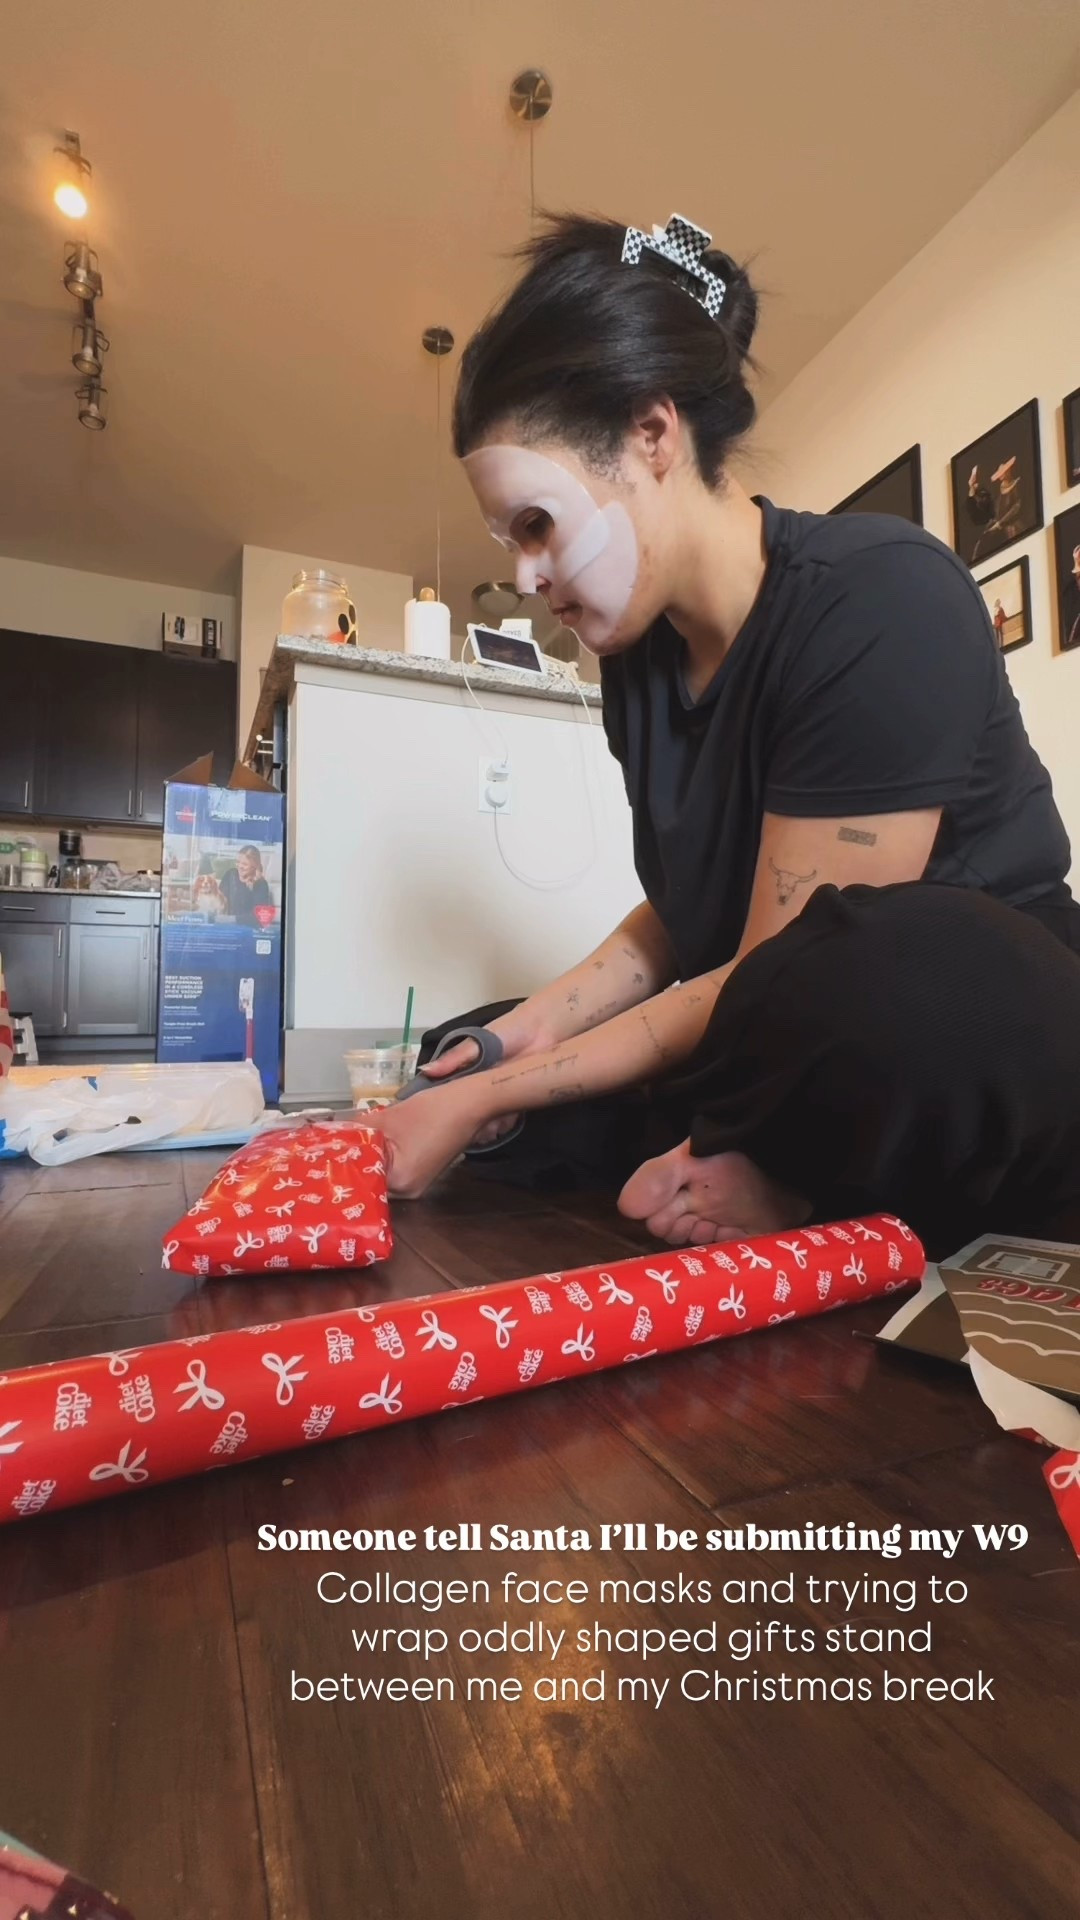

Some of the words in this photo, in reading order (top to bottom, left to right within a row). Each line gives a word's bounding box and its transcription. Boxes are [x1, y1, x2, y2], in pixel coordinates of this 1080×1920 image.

[324, 1327, 342, 1364] Coke
[340, 1334, 355, 1362] diet
[371, 1325, 390, 1351] diet
[383, 1321, 406, 1360] Coke
[448, 1352, 475, 1390] Coke
[458, 1364, 478, 1392] diet
[517, 1348, 534, 1374] diet
[520, 1349, 544, 1382] Coke
[53, 1382, 79, 1431] Coke
[72, 1392, 92, 1428] diet
[117, 1380, 138, 1413] diet
[134, 1374, 156, 1422] Coke
[209, 1411, 246, 1454] Coke
[302, 1404, 323, 1432] diet
[305, 1405, 336, 1440] Coke
[222, 1425, 248, 1455] diet
[11, 1480, 40, 1509] diet
[19, 1480, 57, 1516] Coke
